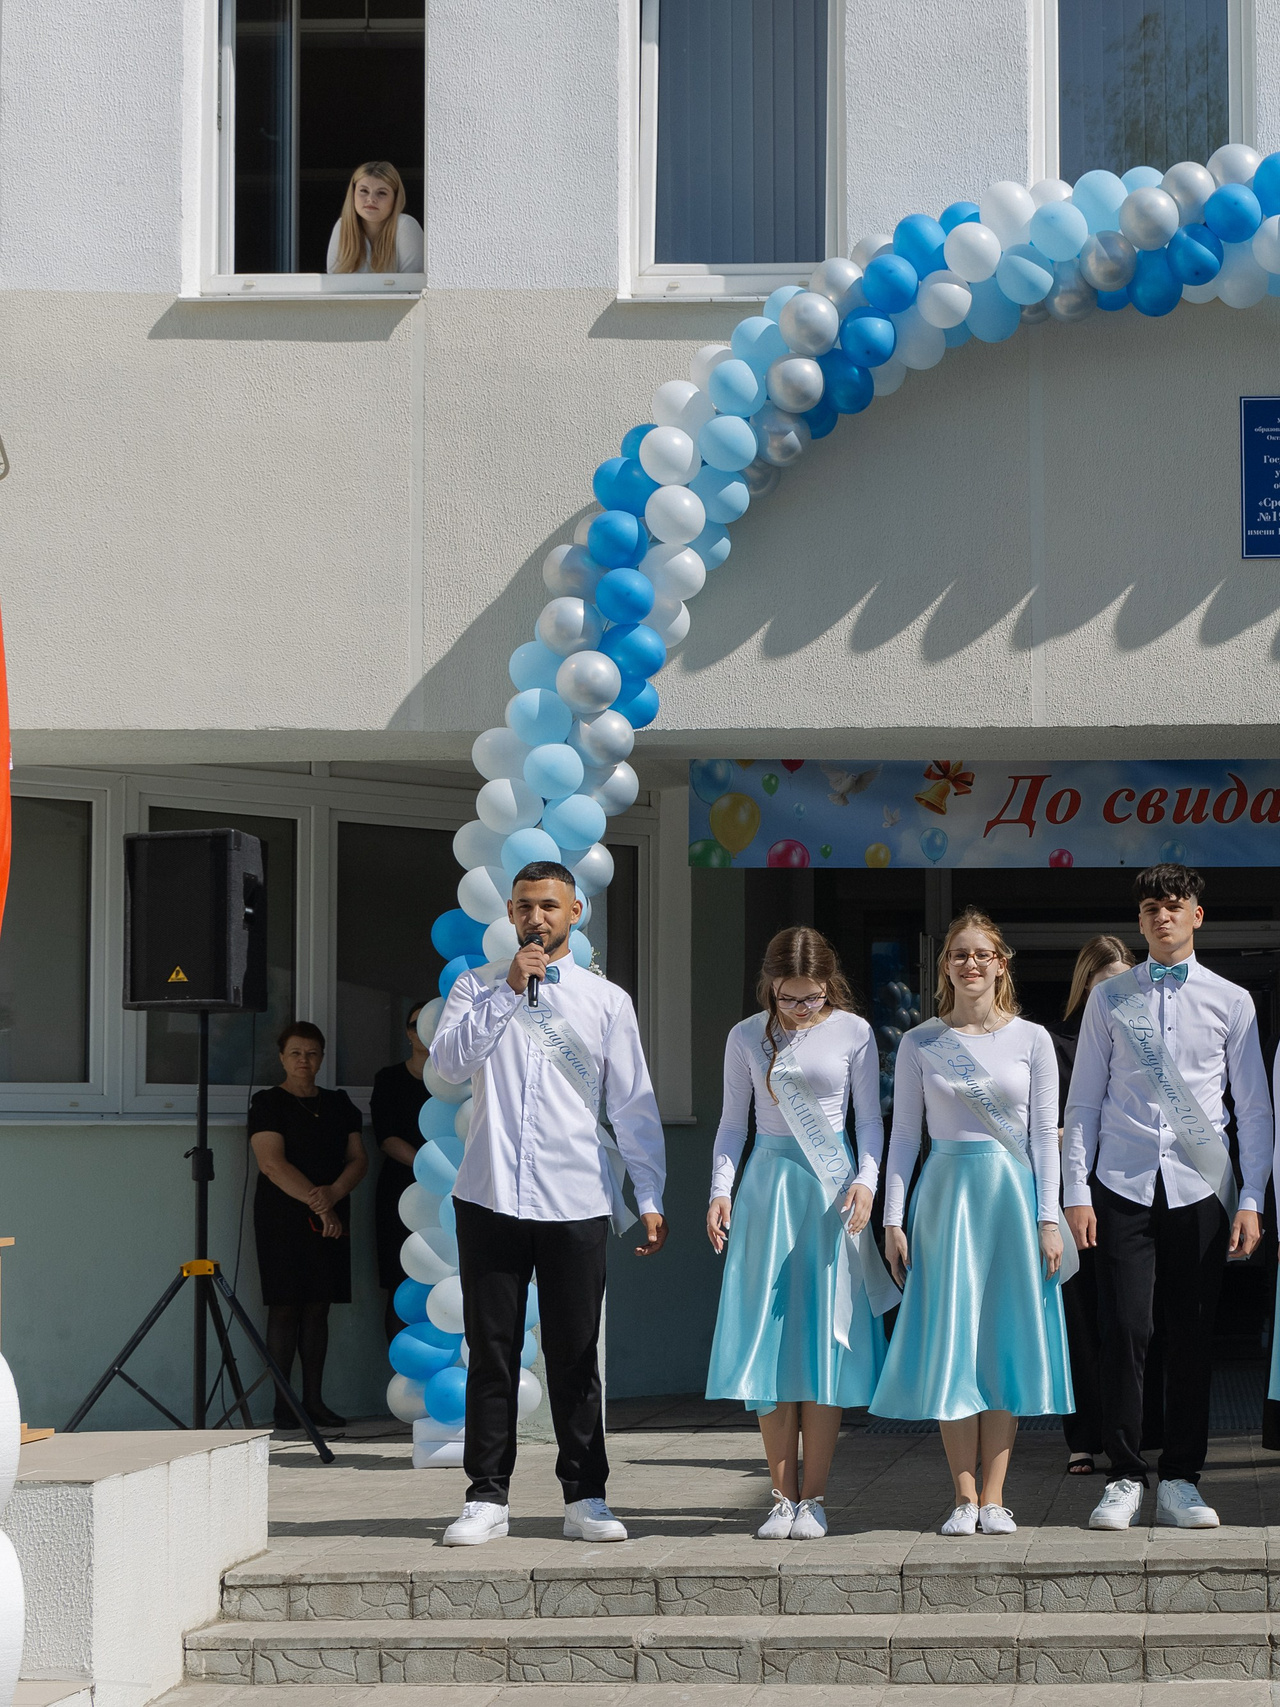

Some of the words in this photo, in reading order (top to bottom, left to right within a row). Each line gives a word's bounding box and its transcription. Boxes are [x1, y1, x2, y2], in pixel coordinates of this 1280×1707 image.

[983, 774, 1082, 838] До
[523, 1001, 590, 1080] Выпускник
[947, 1054, 1014, 1133] Выпускница
[1128, 1015, 1180, 1106] Выпускник
[1174, 1105, 1211, 1146] 2024
[818, 1144, 851, 1196] 2024
